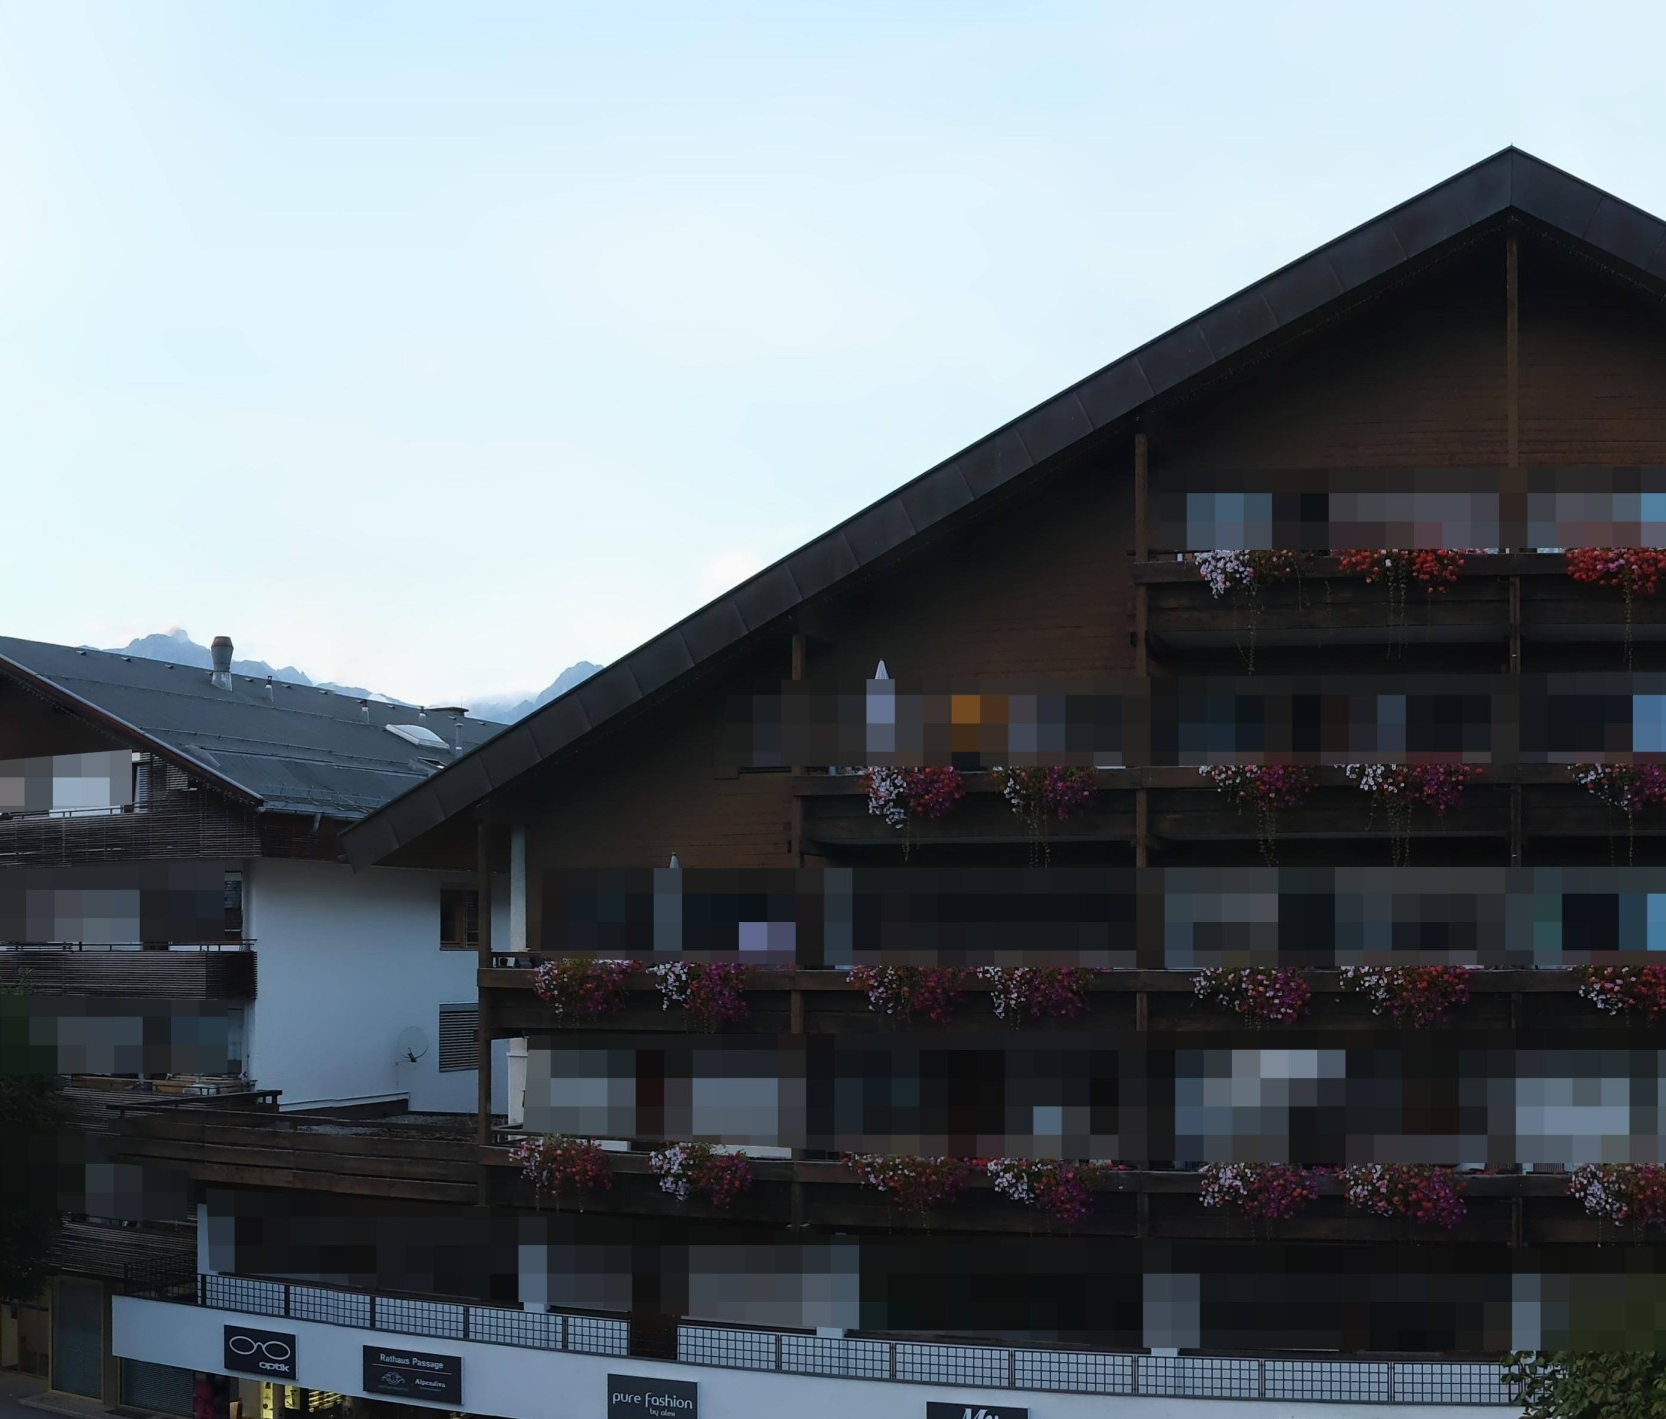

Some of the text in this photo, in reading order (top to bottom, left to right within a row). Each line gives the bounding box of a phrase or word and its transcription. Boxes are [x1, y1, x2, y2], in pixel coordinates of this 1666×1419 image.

[258, 1361, 290, 1373] optik
[379, 1353, 443, 1370] Rathaus Passage
[612, 1391, 693, 1409] pure fashion
[649, 1407, 659, 1417] by
